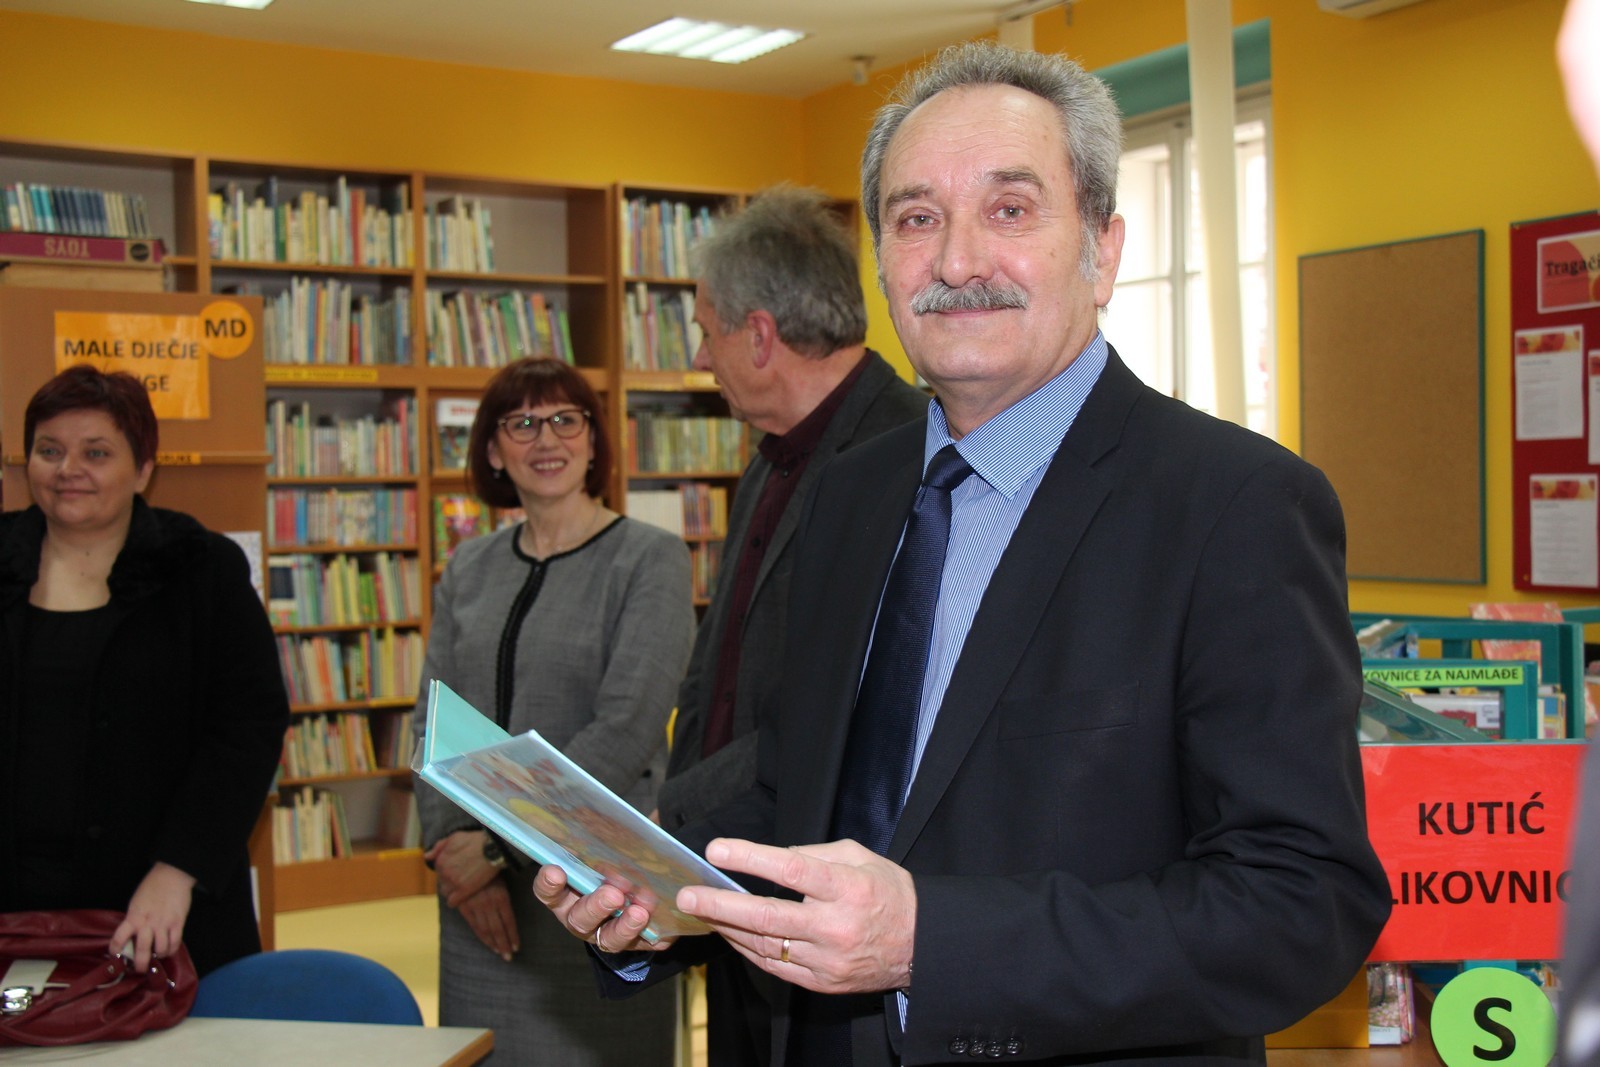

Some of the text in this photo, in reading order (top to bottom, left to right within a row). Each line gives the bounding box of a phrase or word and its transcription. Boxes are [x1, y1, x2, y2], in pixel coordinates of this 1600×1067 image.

[44, 236, 90, 258] TOYS
[205, 318, 246, 338] MD
[64, 339, 200, 360] MALE DJEČJE
[137, 373, 170, 393] GE
[1424, 670, 1442, 681] ZA
[1445, 668, 1519, 681] NAJMLAĐE
[1418, 791, 1546, 836] KUTIĆ
[1391, 870, 1576, 905] IKOVNIC
[1472, 996, 1517, 1062] S
